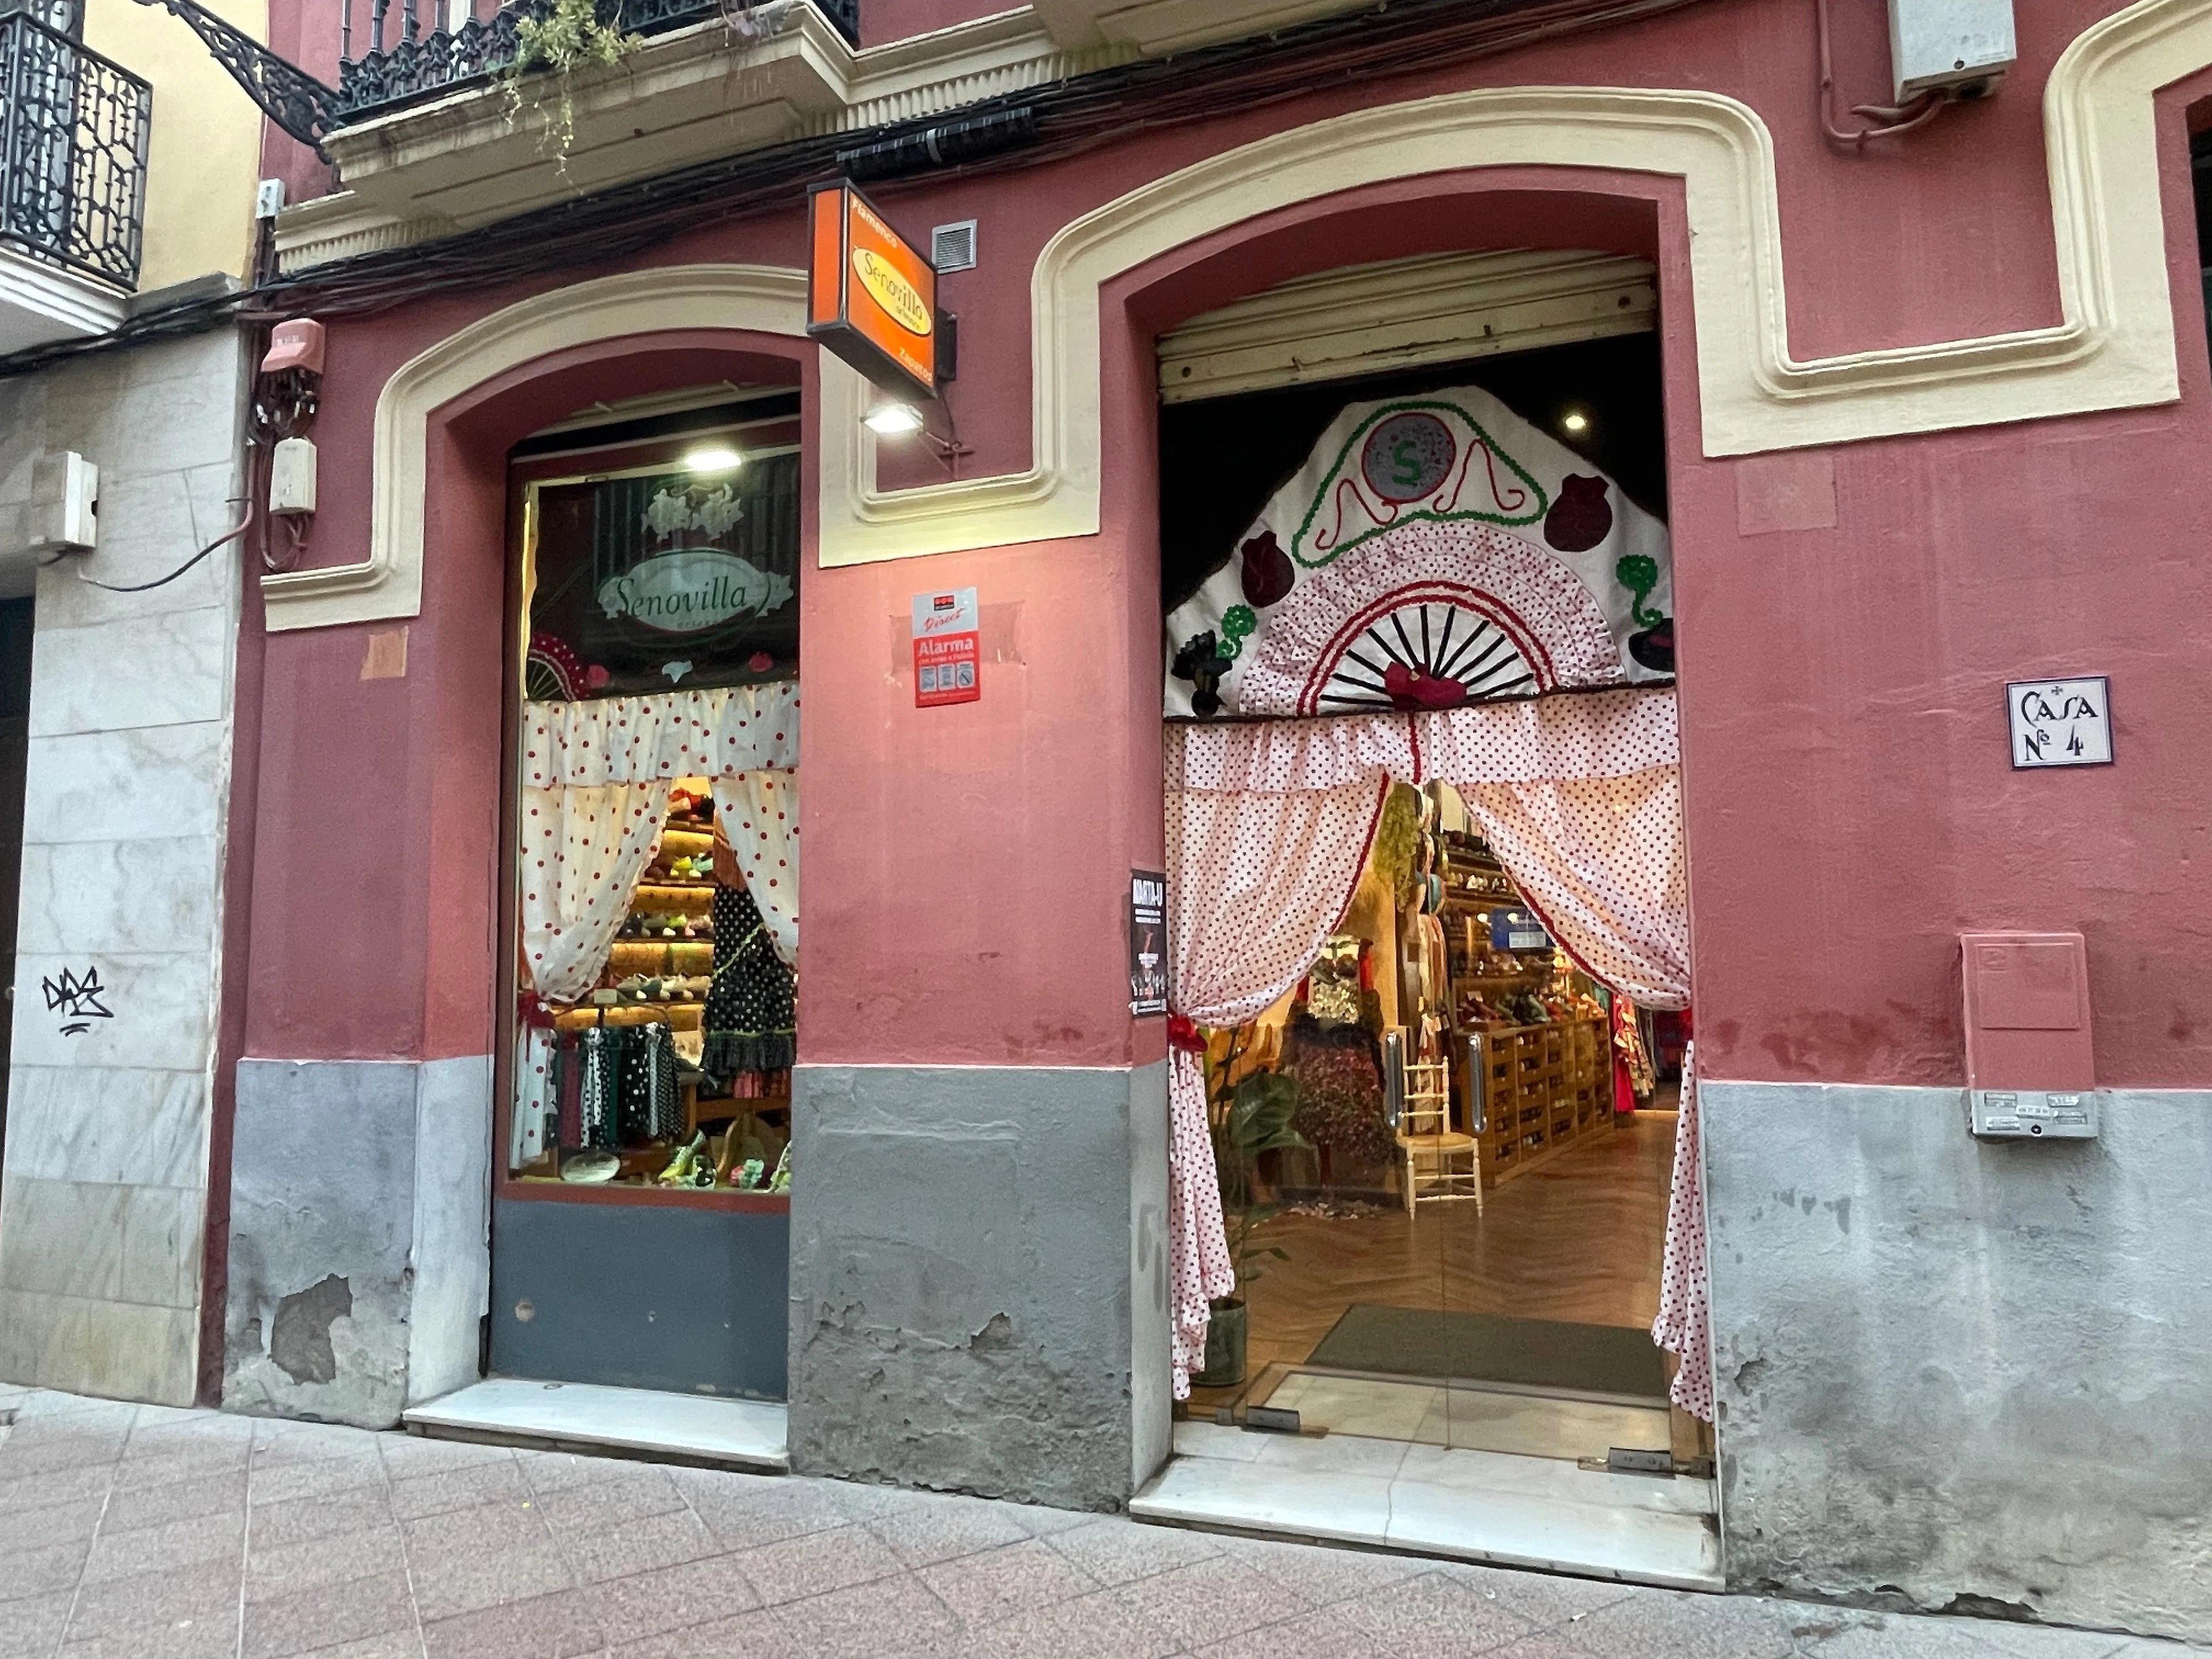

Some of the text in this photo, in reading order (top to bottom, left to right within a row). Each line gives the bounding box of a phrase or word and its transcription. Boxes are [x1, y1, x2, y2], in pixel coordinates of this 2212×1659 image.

[853, 198, 898, 248] Flamenco
[899, 347, 932, 382] Zapatos
[1392, 440, 1421, 485] S
[617, 575, 748, 617] Senovilla
[918, 637, 974, 657] Alarma
[2021, 691, 2099, 729] CASA
[2066, 724, 2084, 756] 4
